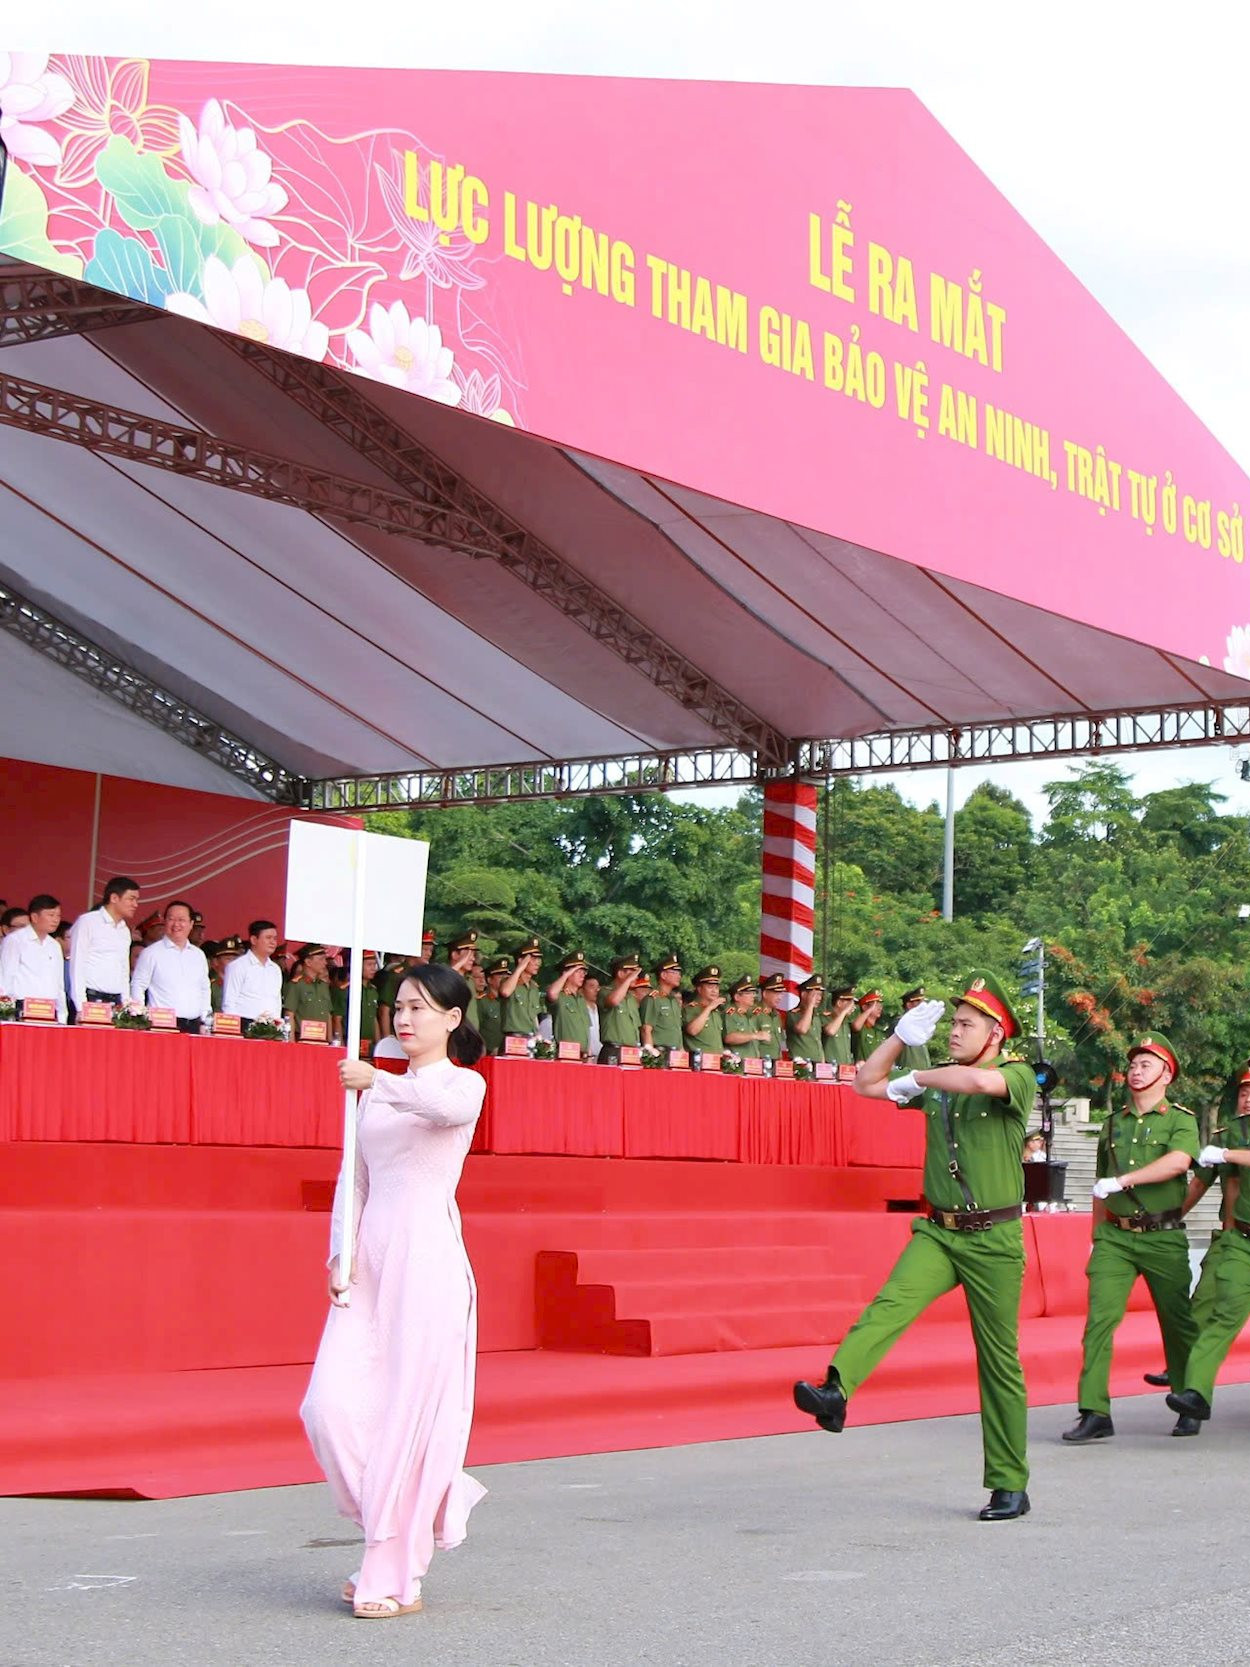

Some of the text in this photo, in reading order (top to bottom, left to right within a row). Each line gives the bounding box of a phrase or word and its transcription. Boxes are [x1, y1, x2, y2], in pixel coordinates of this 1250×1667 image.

[403, 149, 1245, 564] LỰC LƯỢNG THAM GIA BẢO VỆ AN NINH, TRẬT TỰ Ở CƠ SỞ
[808, 199, 1008, 374] LỄ RA MẮT
